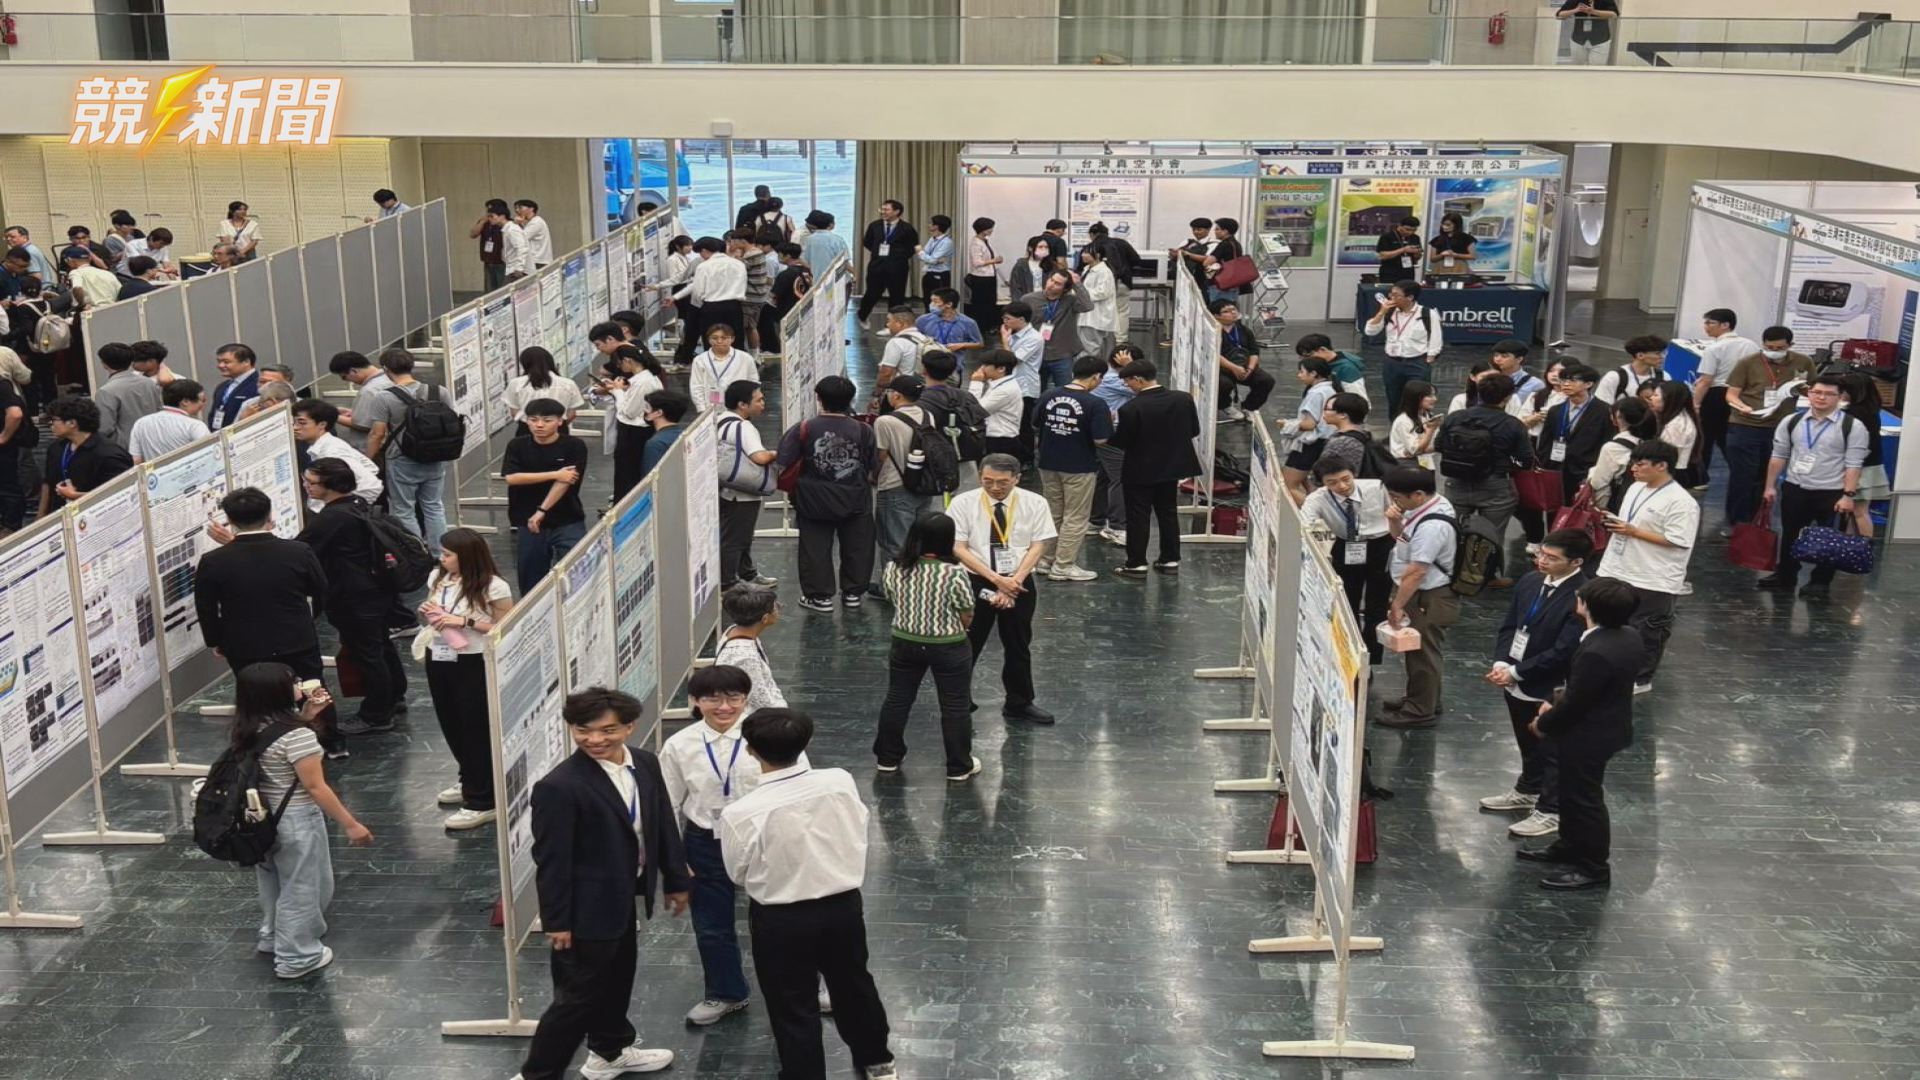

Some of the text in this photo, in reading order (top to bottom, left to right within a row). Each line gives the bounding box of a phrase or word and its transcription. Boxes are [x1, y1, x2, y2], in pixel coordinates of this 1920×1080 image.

[1081, 159, 1180, 169] 台灣真空學會
[1440, 307, 1514, 323] mbrell
